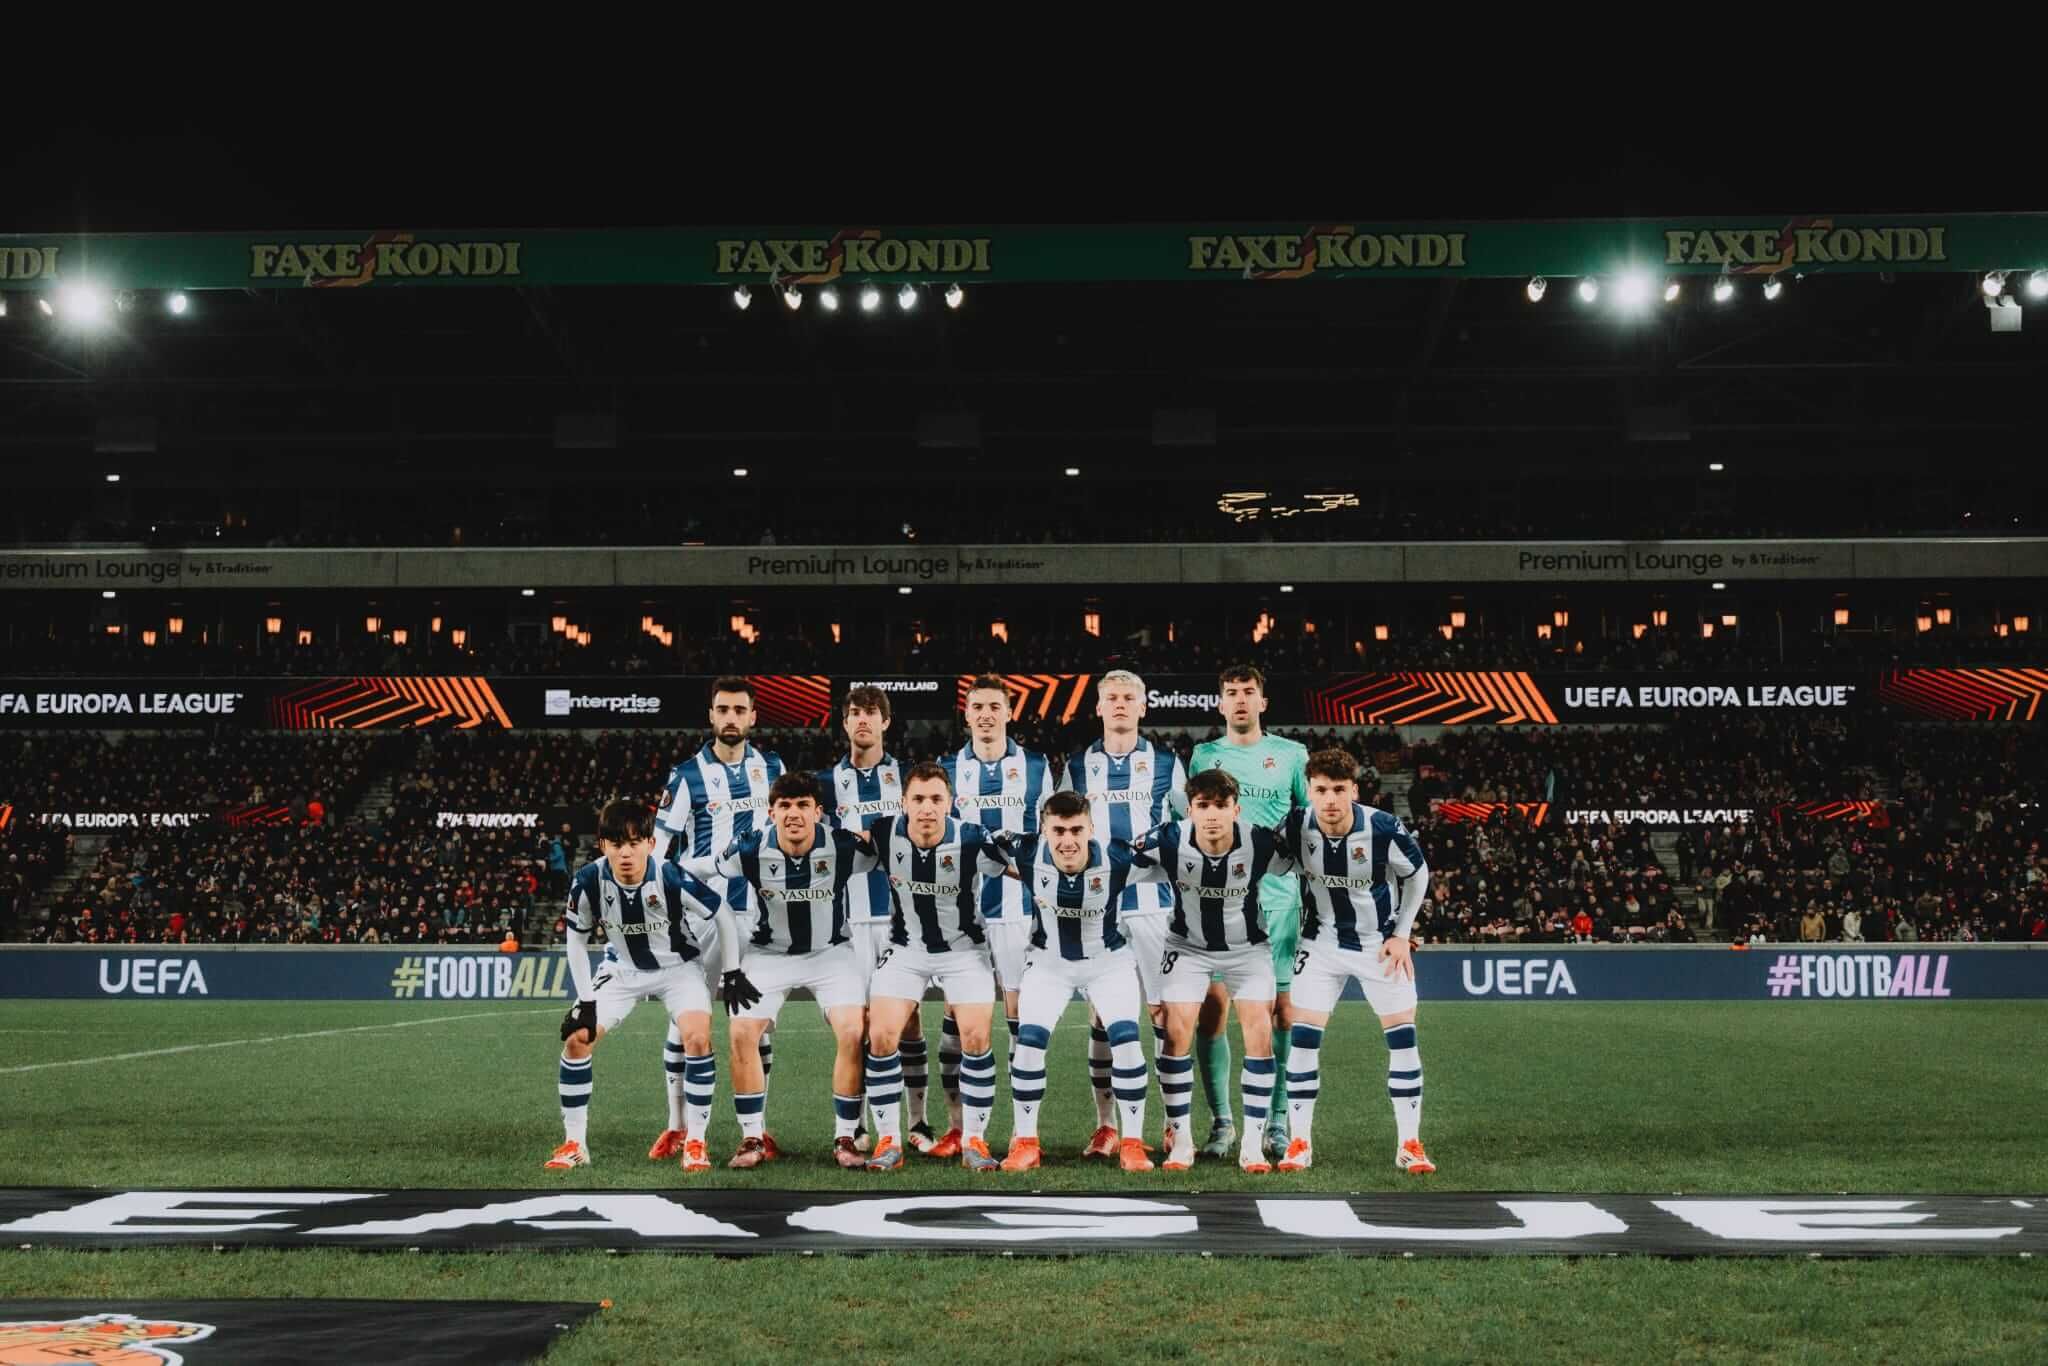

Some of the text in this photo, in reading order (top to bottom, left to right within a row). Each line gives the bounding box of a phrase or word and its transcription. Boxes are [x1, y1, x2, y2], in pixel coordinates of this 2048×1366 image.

[717, 239, 991, 272] FAXE KONDI
[1189, 234, 1466, 269] FAXE KONDI
[1665, 227, 1946, 264] FAXE KONDI
[251, 242, 520, 277] FAXE KONDI
[96, 560, 180, 583] Lounge
[189, 563, 202, 576] by
[748, 555, 855, 575] Premium
[864, 556, 949, 579] Lounge
[1519, 550, 1627, 570] Premium
[1636, 551, 1722, 575] Lounge
[1732, 554, 1745, 567] by
[36, 694, 133, 713] EUROPA
[1148, 690, 1220, 711] Swissqu
[1565, 687, 1633, 707] UEFA
[1639, 687, 1742, 706] EUROPA
[853, 799, 901, 813] YASUDA
[973, 795, 1024, 808] YASUDA
[1102, 792, 1152, 802] YASUDA
[906, 881, 960, 896] YASUDA
[1194, 886, 1248, 898] YASUDA
[1319, 875, 1373, 889] YASUDA
[779, 888, 833, 900] YASUDA
[1052, 906, 1105, 919] YASUDA
[618, 920, 671, 934] YASUDA
[100, 959, 208, 994] UEFA
[391, 957, 569, 998] #FOOTBALL
[1462, 959, 1577, 994] UEFA
[1766, 955, 1951, 997] #FOOTBALL
